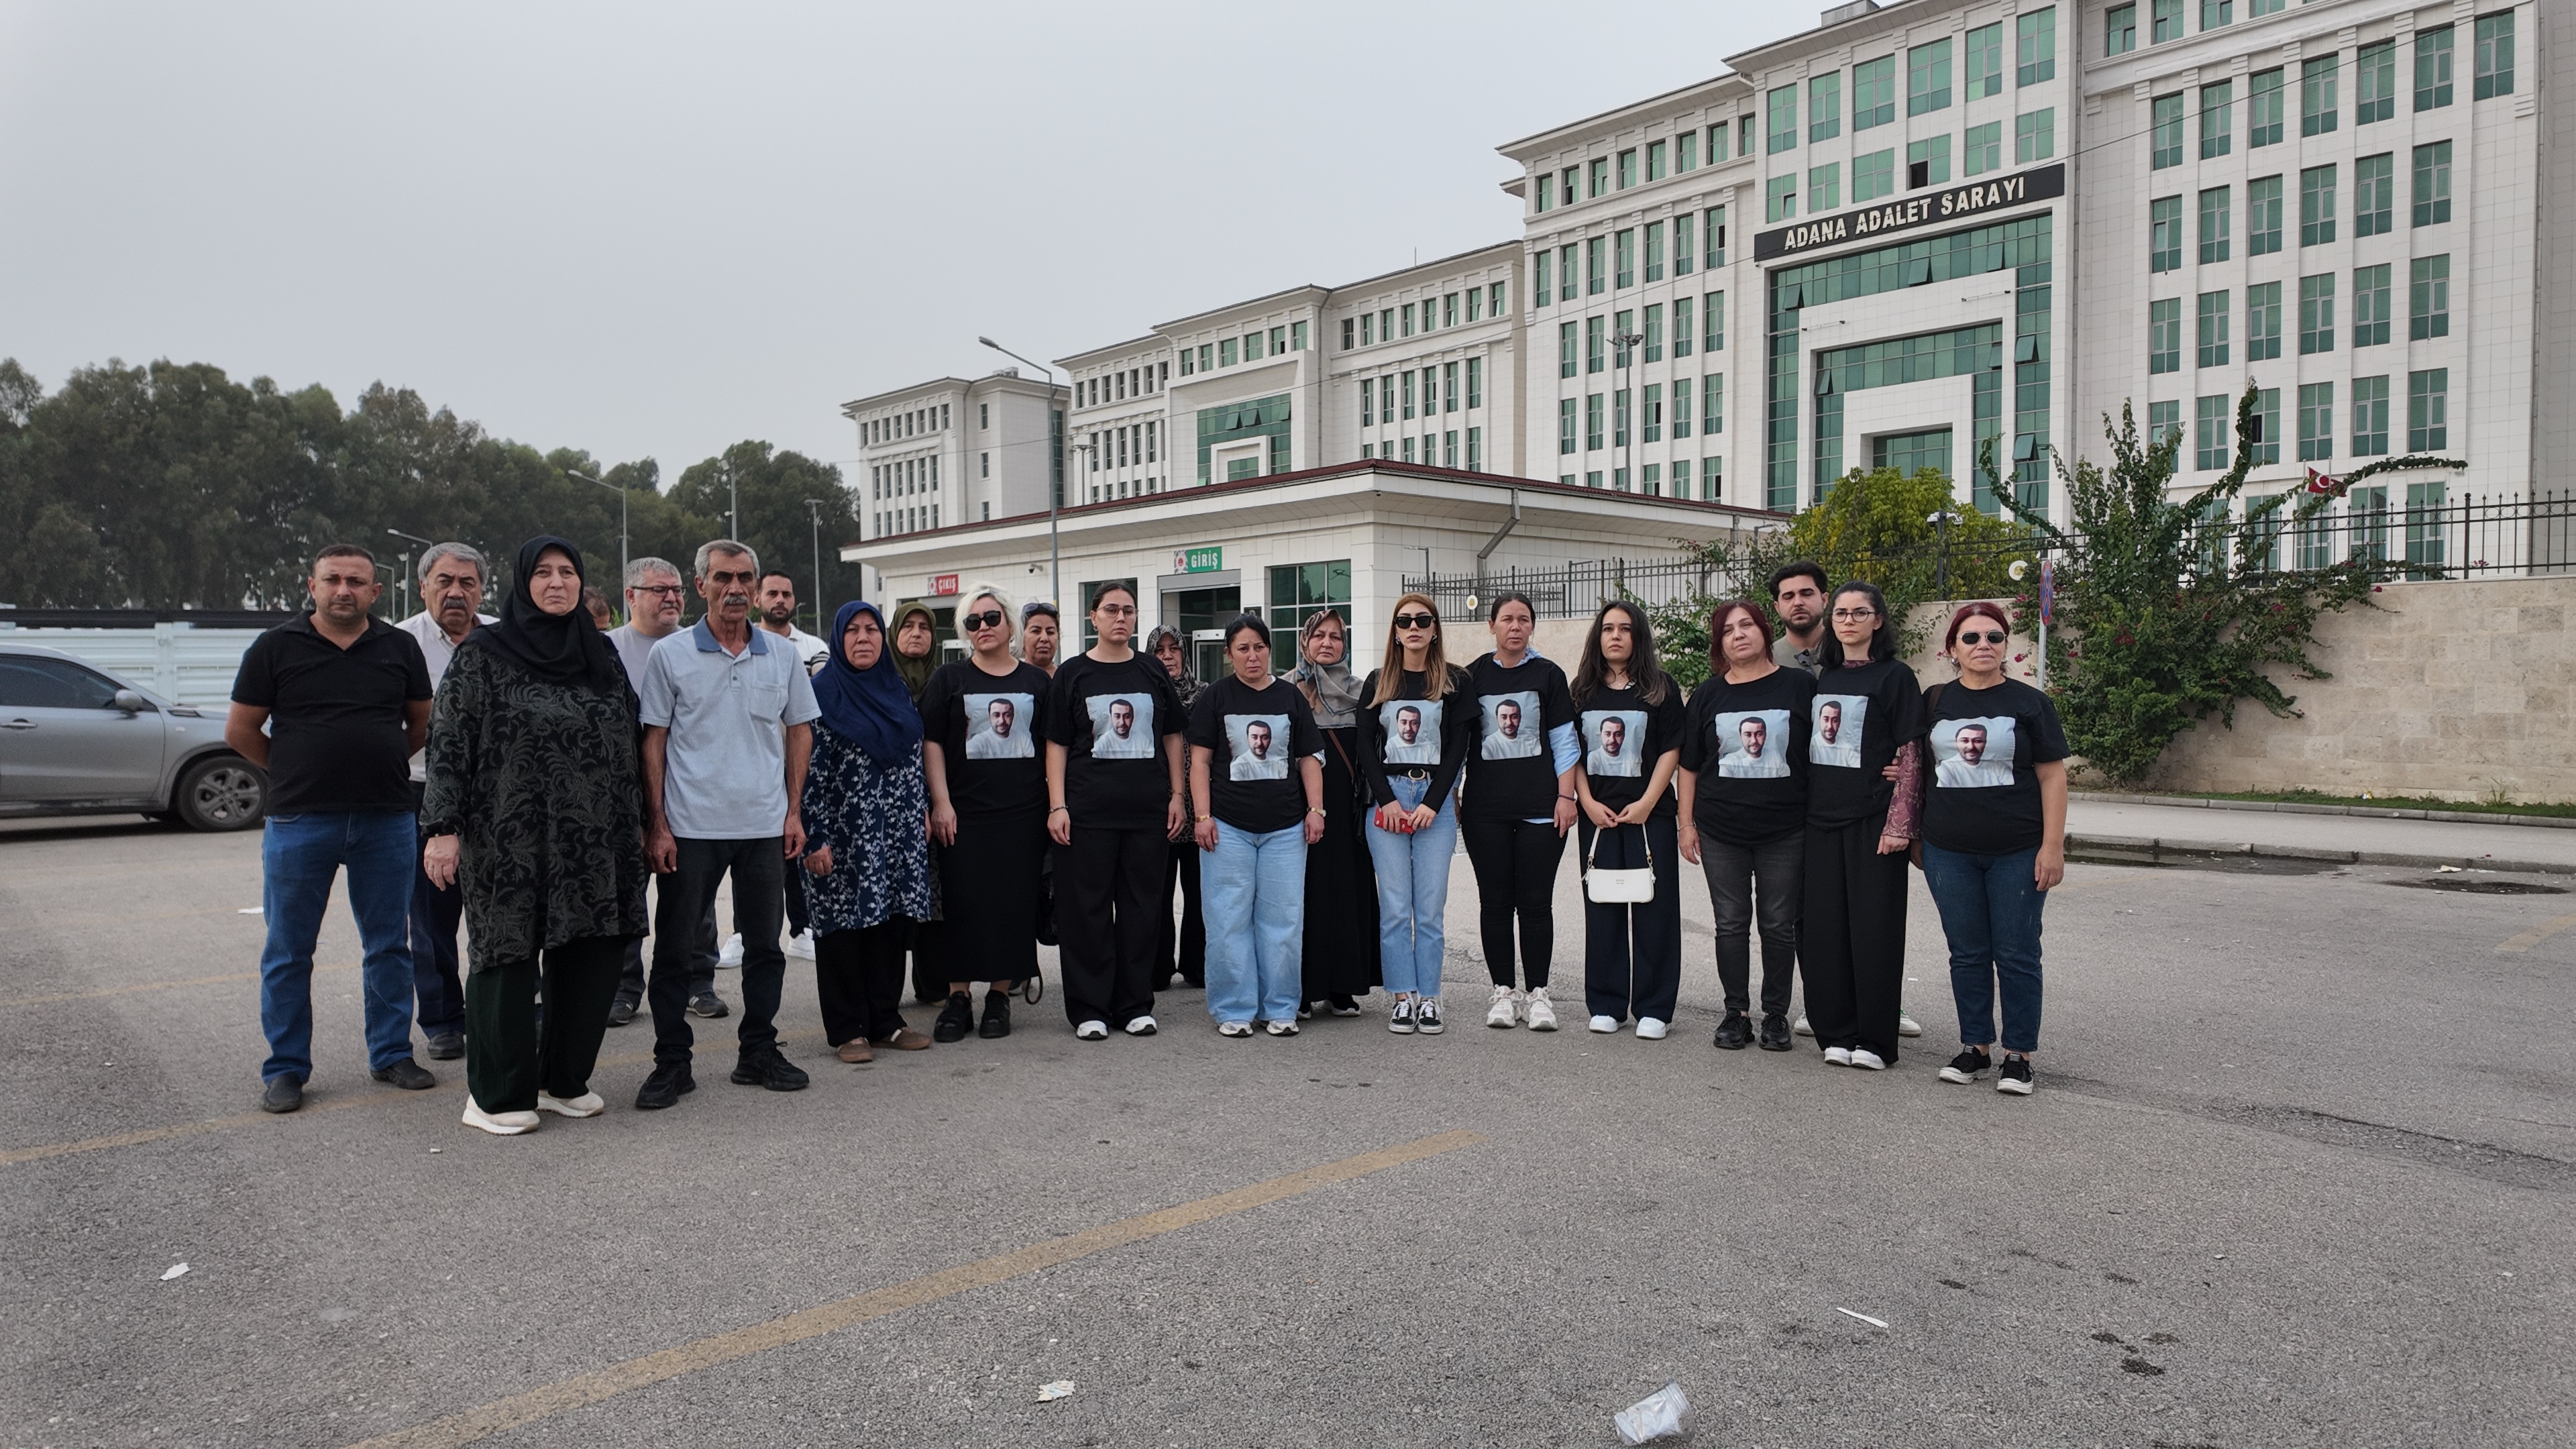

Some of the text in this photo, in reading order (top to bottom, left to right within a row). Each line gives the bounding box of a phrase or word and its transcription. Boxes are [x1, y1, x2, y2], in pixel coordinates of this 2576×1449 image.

[1784, 176, 2024, 250] ADANA ADALET SARAYI
[1191, 550, 1218, 570] GİRİŞ
